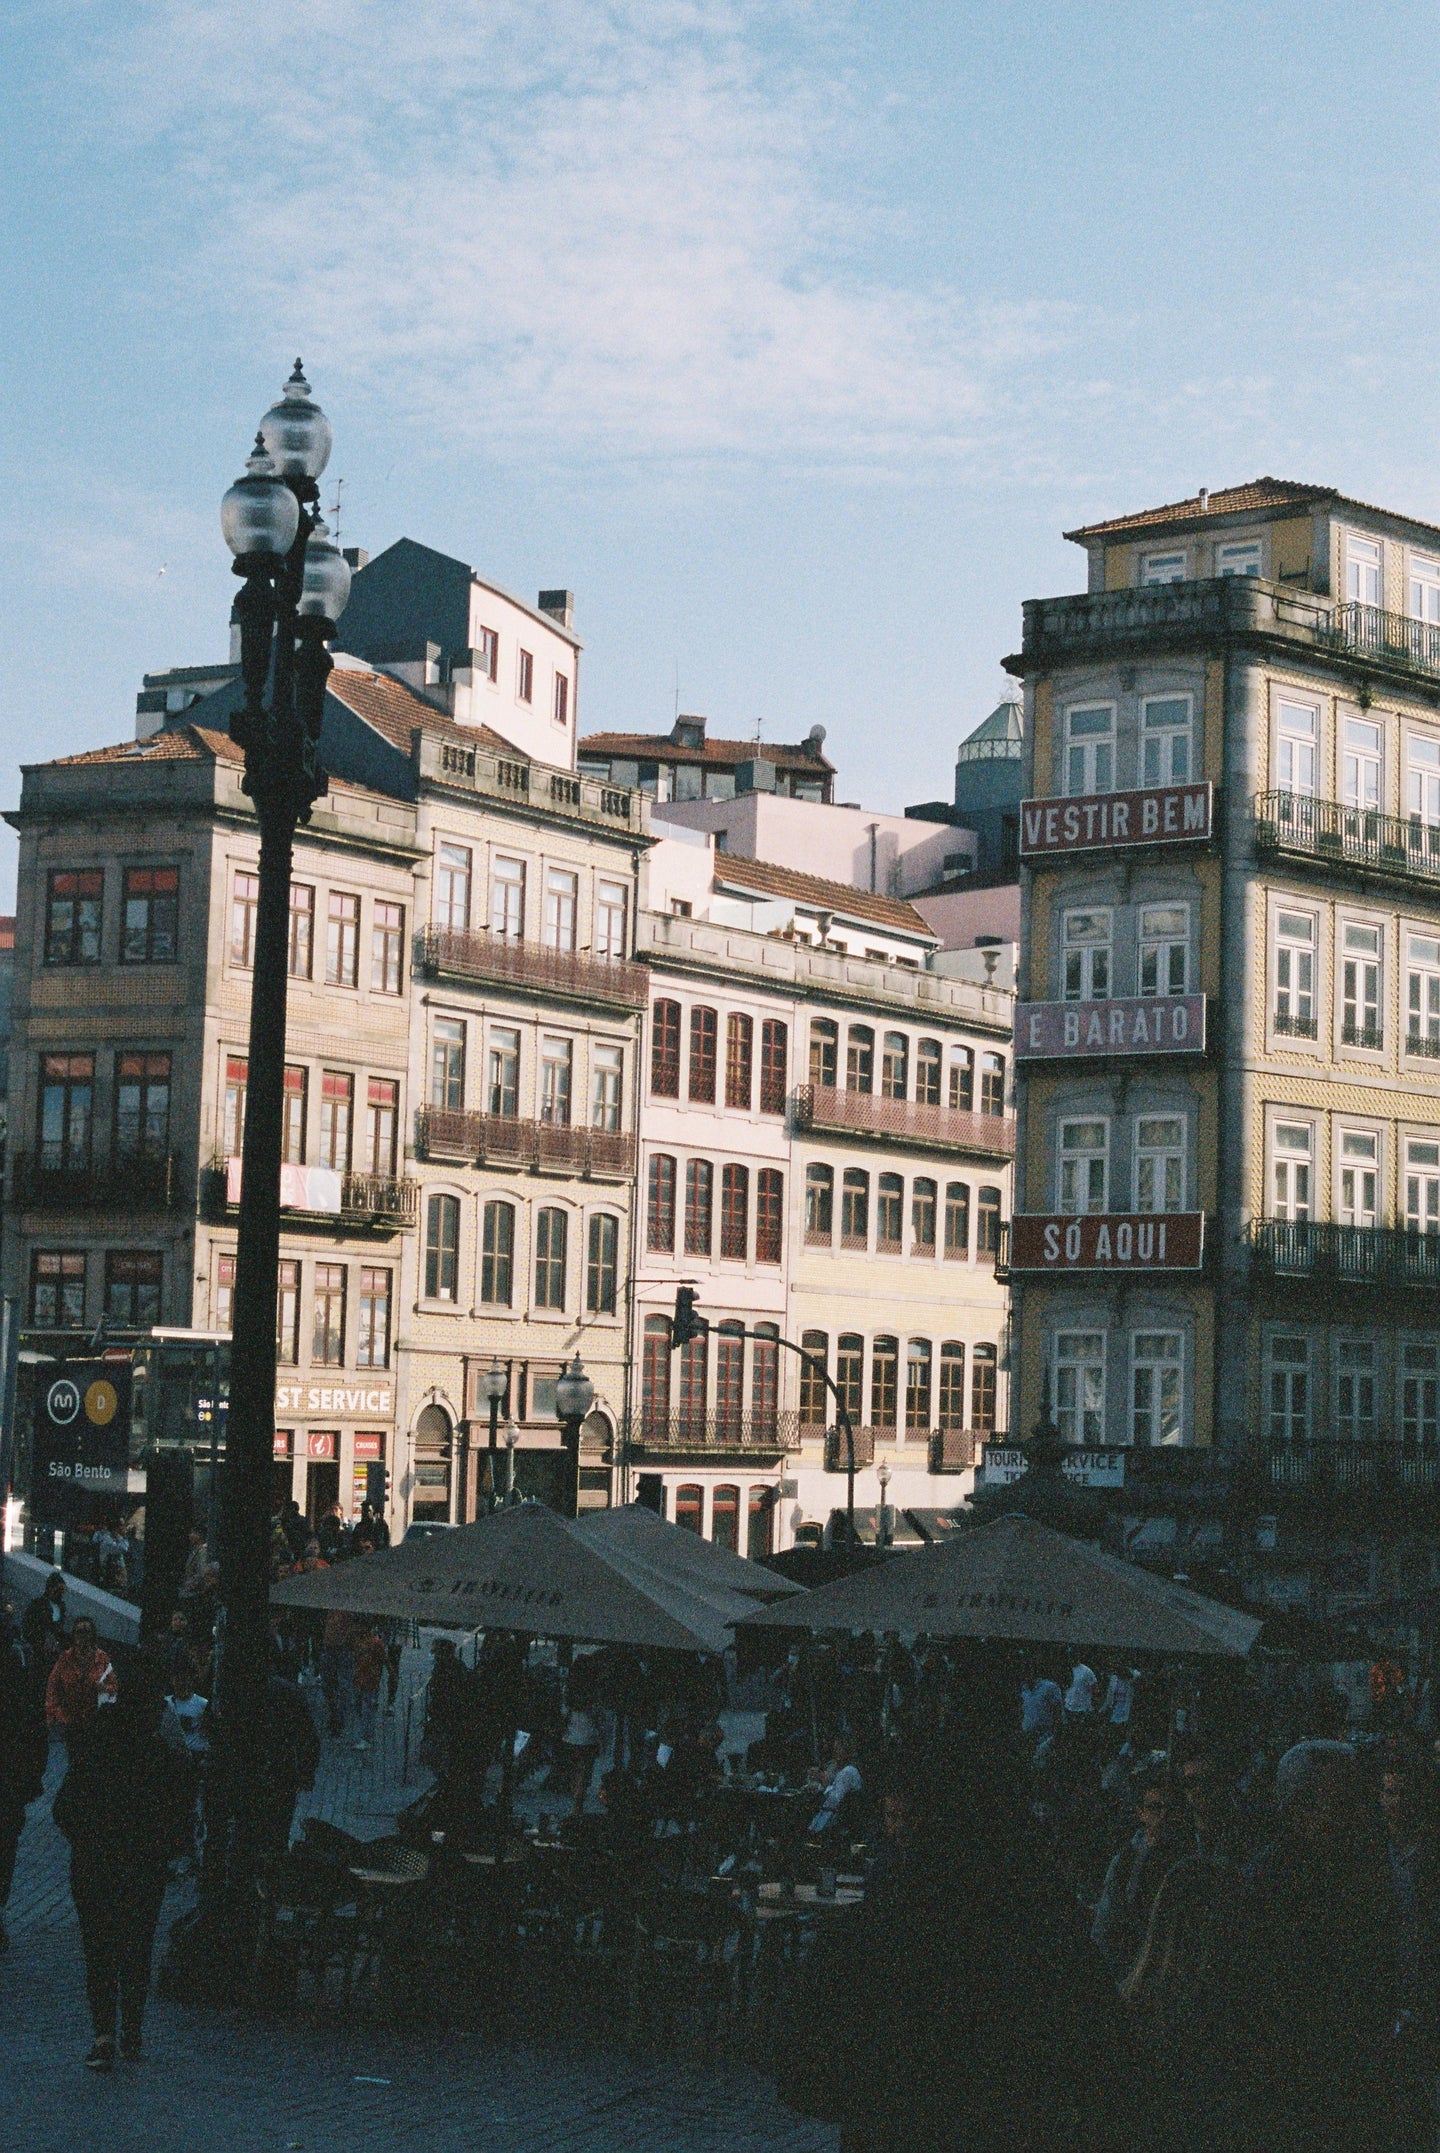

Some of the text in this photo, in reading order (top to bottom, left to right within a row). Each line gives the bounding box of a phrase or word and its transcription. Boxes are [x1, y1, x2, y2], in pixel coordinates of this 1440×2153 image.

[1025, 793, 1205, 845] VESTIR BEM
[1029, 1005, 1187, 1048] E BARATO
[1043, 1217, 1166, 1261] SÓ AQUI
[96, 1394, 106, 1410] D
[308, 1388, 391, 1412] SERVICE
[49, 1461, 111, 1479] São Bento
[988, 1452, 1118, 1470] TOURI RVICE
